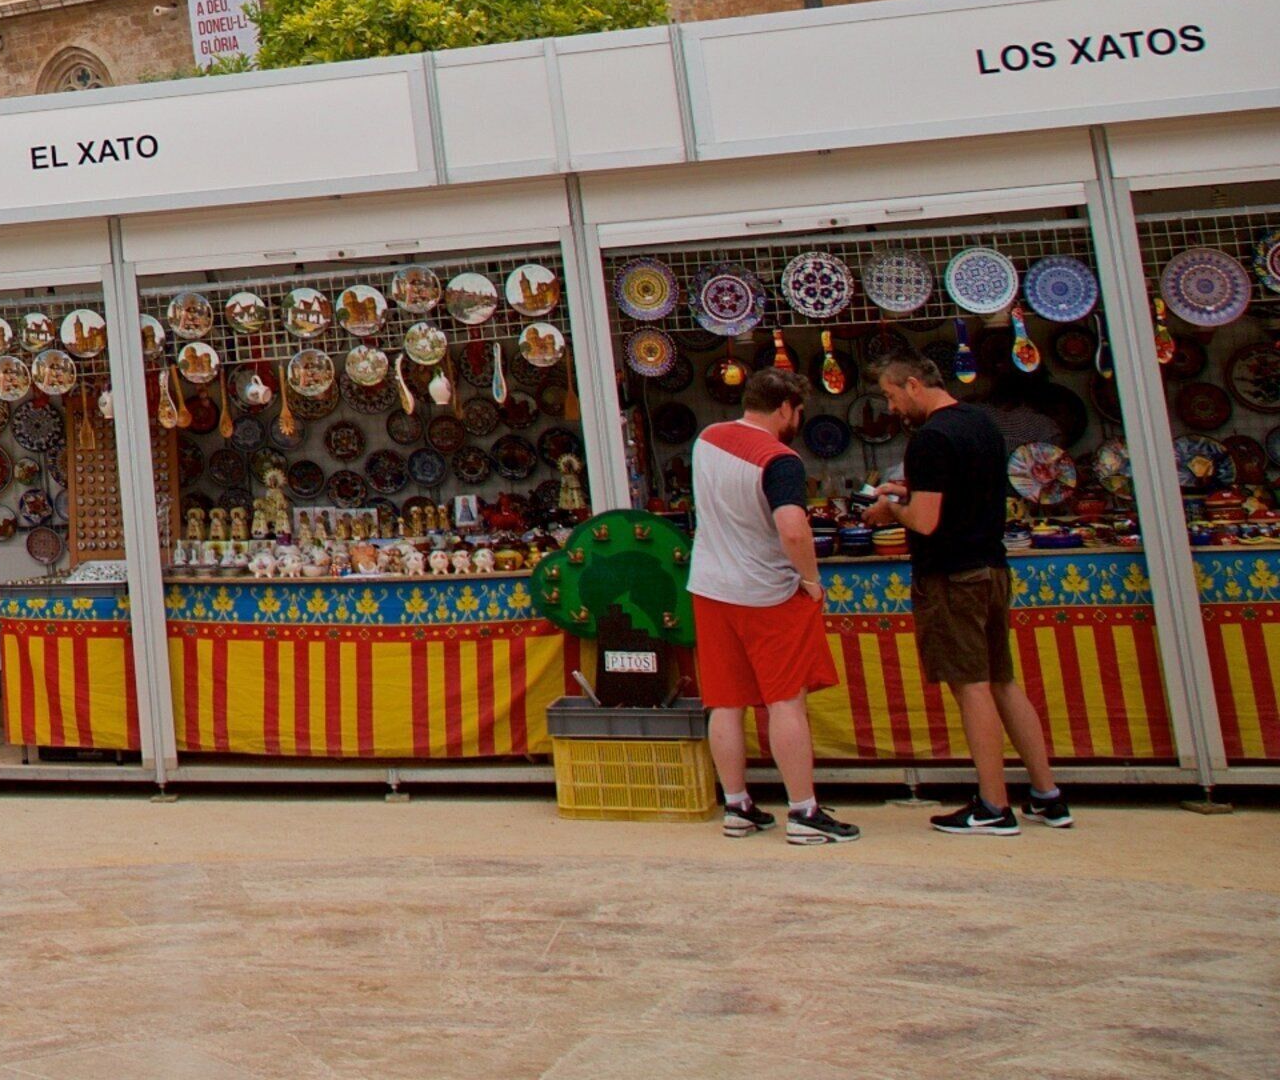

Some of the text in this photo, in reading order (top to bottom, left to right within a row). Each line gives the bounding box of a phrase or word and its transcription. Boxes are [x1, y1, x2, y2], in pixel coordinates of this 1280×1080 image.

[197, 1, 205, 16] A
[200, 35, 240, 55] GLÒRIA
[976, 25, 1206, 75] LOS XATOS
[30, 134, 159, 170] EL XATO
